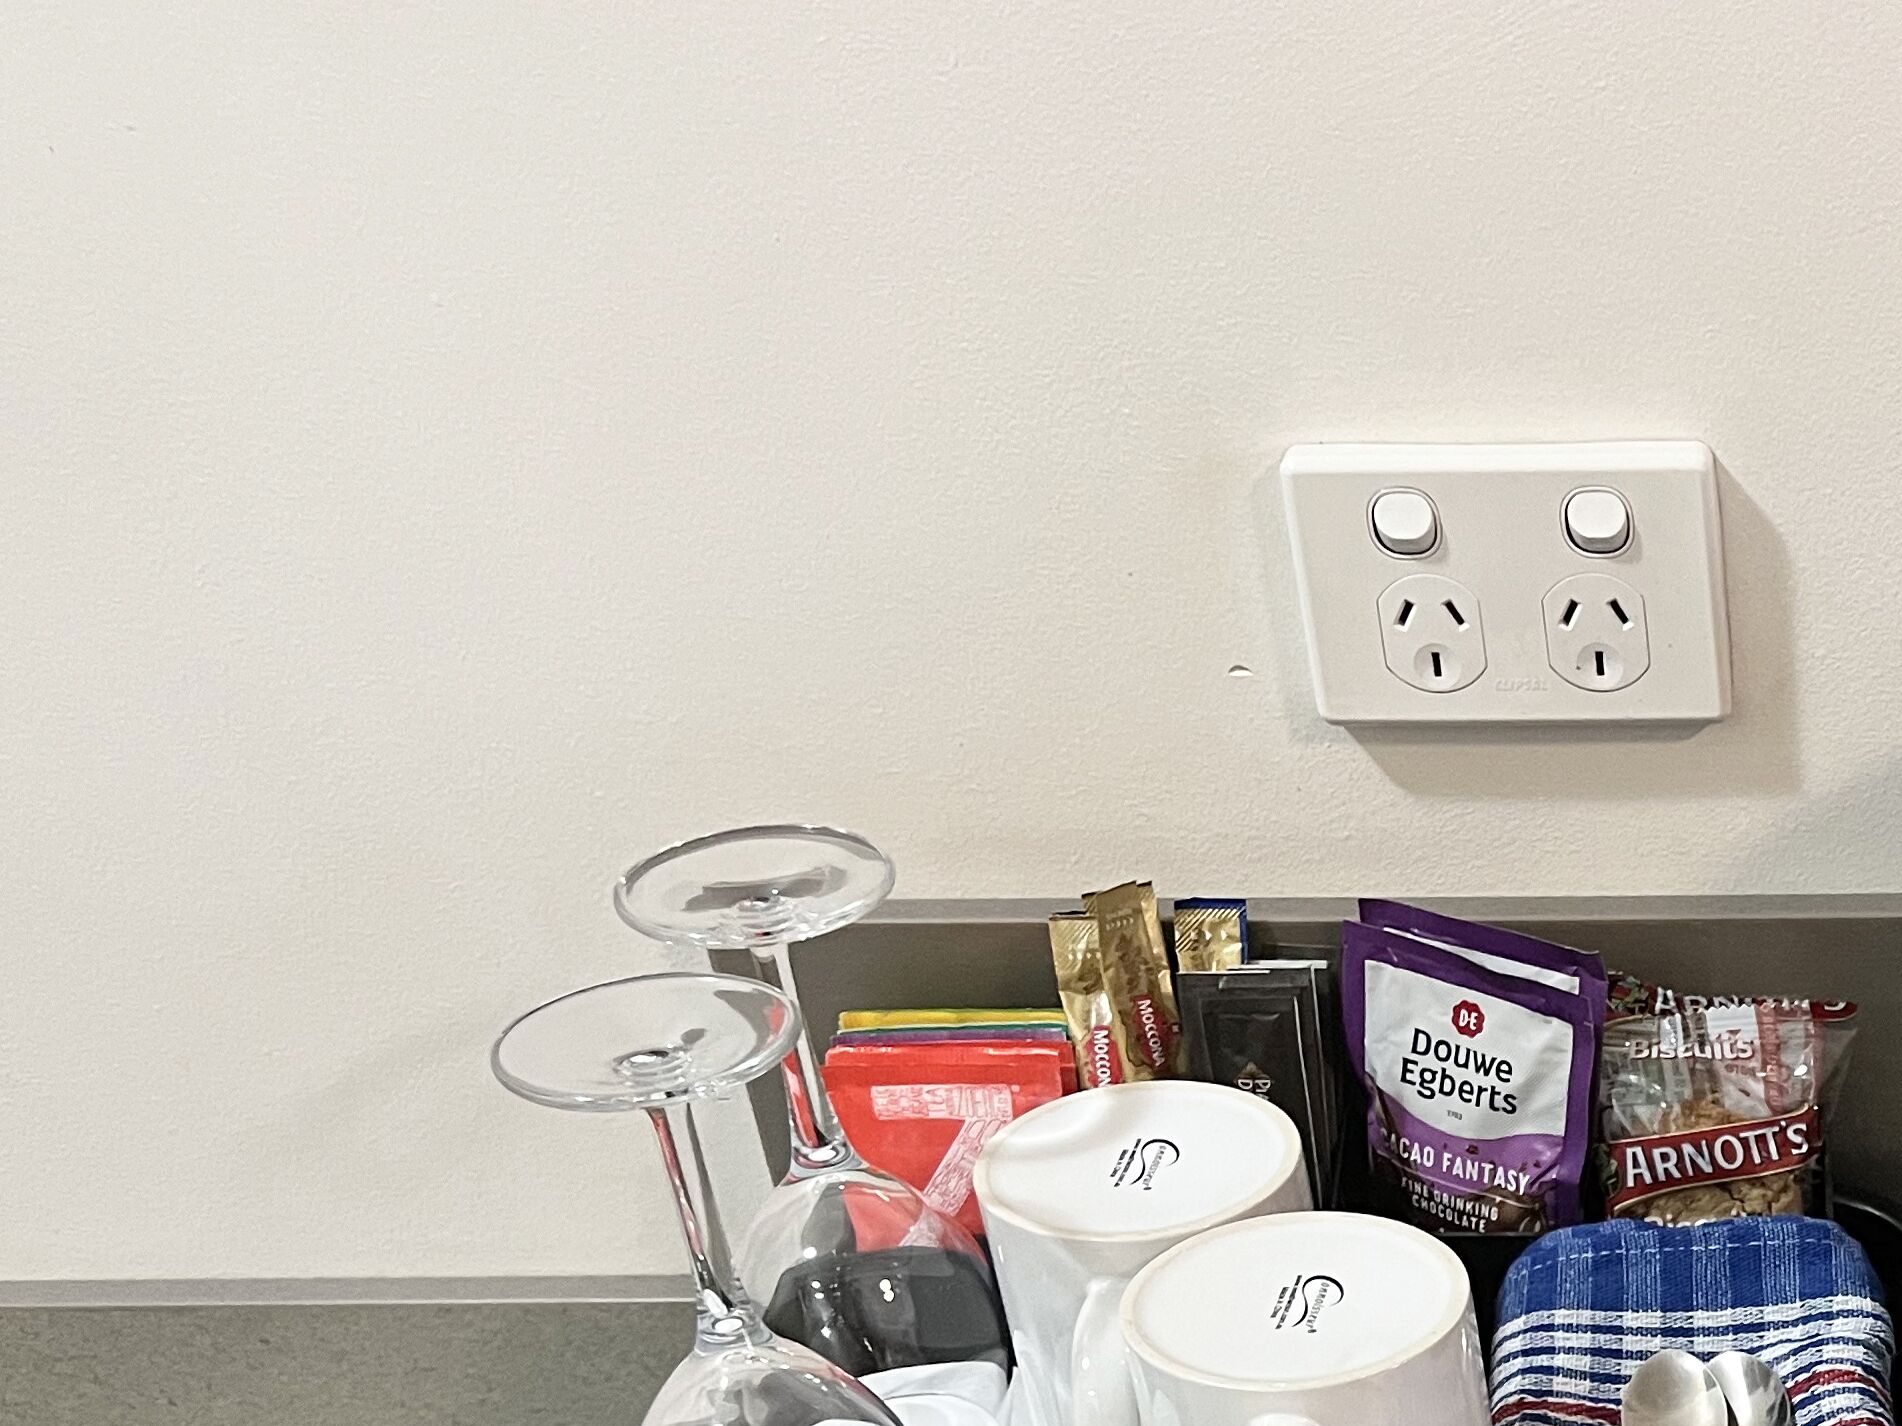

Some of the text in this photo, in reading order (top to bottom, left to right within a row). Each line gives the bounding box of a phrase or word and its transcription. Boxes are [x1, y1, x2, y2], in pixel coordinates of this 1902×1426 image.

[1092, 1029, 1112, 1087] MOCCON
[1137, 998, 1166, 1068] MOCCONA
[1410, 1027, 1514, 1084] Douwe
[1399, 1056, 1518, 1116] Egberts
[1442, 1151, 1531, 1196] FANTASY
[1625, 1120, 1810, 1188] ARNOTT'S
[1401, 1176, 1499, 1222] FINE DRINKING
[1410, 1194, 1488, 1234] CHOCOLATE
